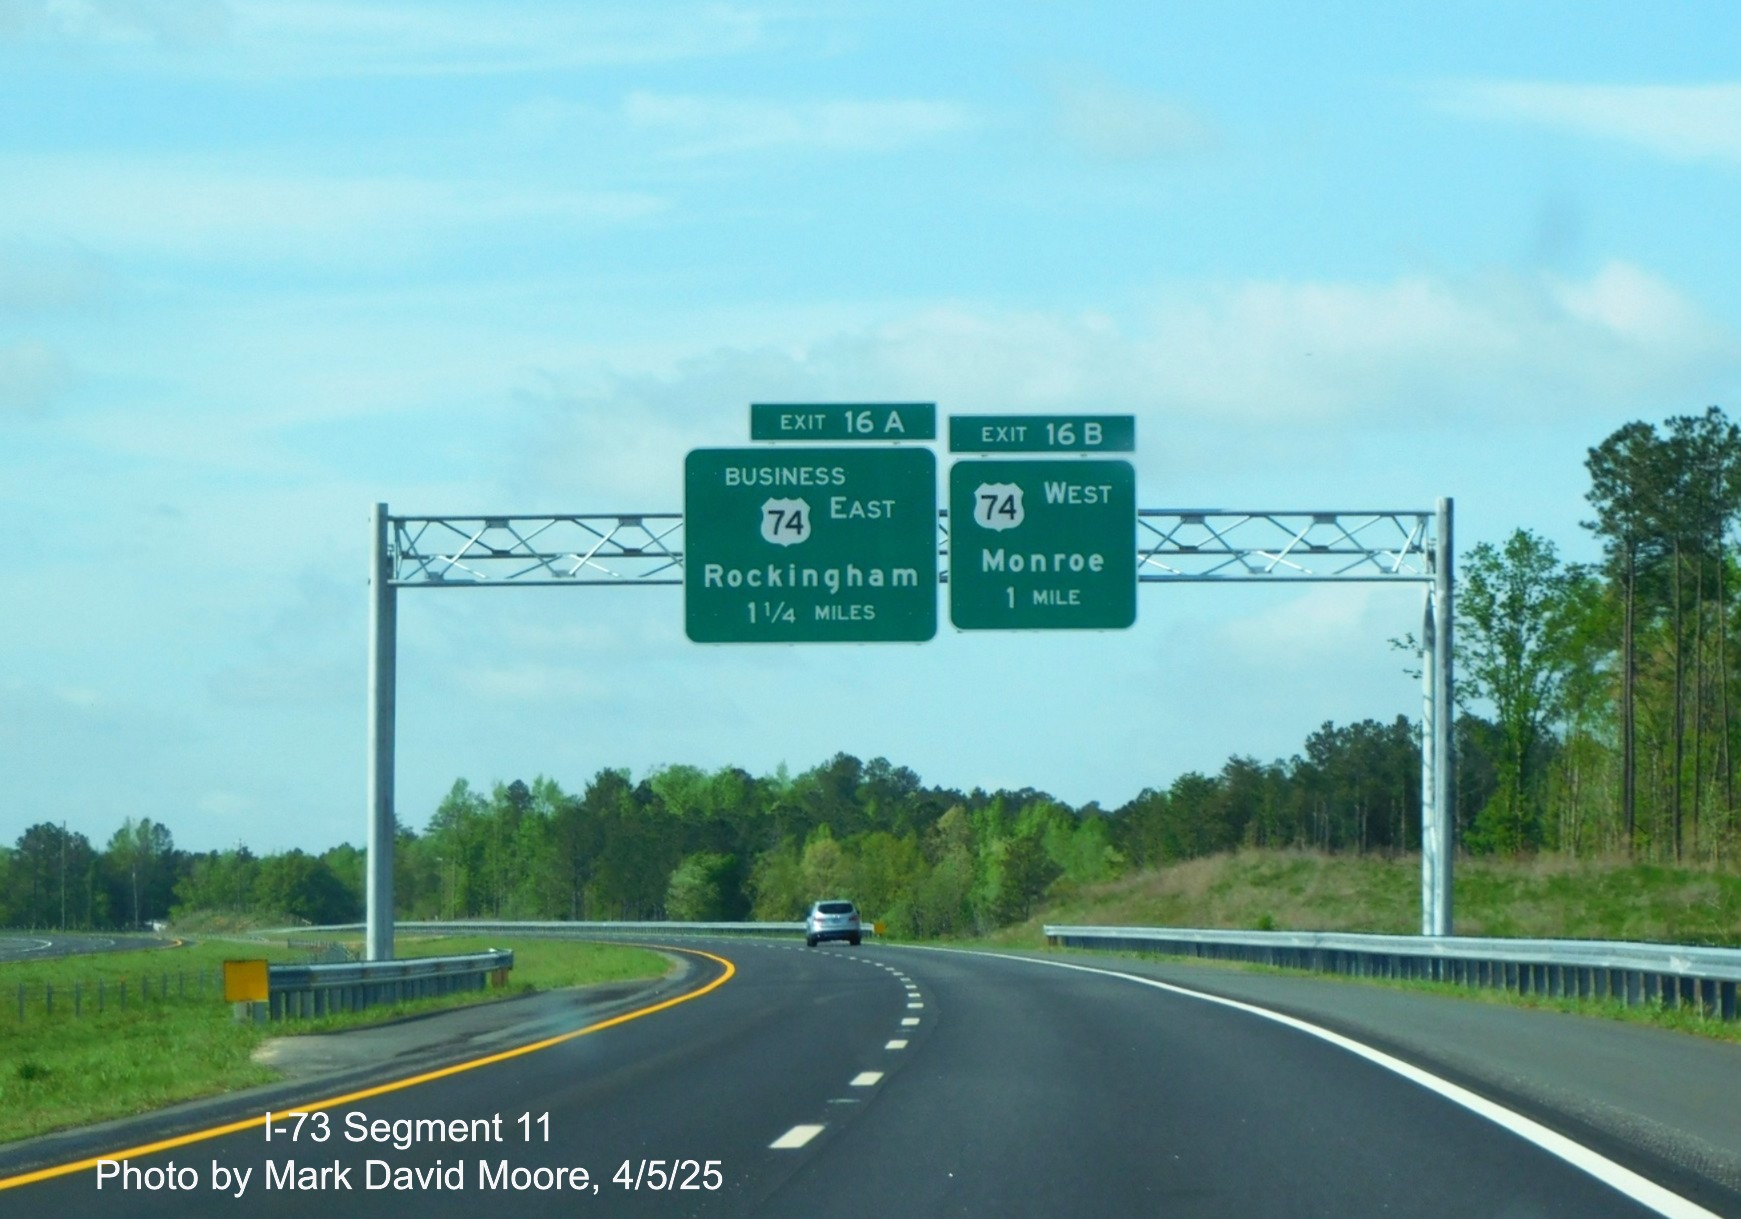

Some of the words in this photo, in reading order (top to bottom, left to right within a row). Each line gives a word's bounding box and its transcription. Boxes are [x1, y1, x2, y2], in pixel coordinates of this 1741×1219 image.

[780, 414, 826, 430] EXIT
[845, 410, 874, 433] 16
[884, 410, 905, 433] A
[982, 426, 1027, 442] EXIT
[1046, 422, 1075, 445] 16
[1084, 423, 1103, 445] B
[725, 467, 846, 486] BUSINESS
[981, 494, 1016, 520] 74
[1044, 482, 1111, 504] WEST
[768, 510, 804, 536] 74
[830, 496, 895, 519] EAST
[982, 549, 1104, 573] Monroe
[704, 563, 918, 594] Rockingham
[1006, 587, 1015, 608] 1
[1033, 590, 1080, 605] MILE
[815, 605, 876, 620] MILES
